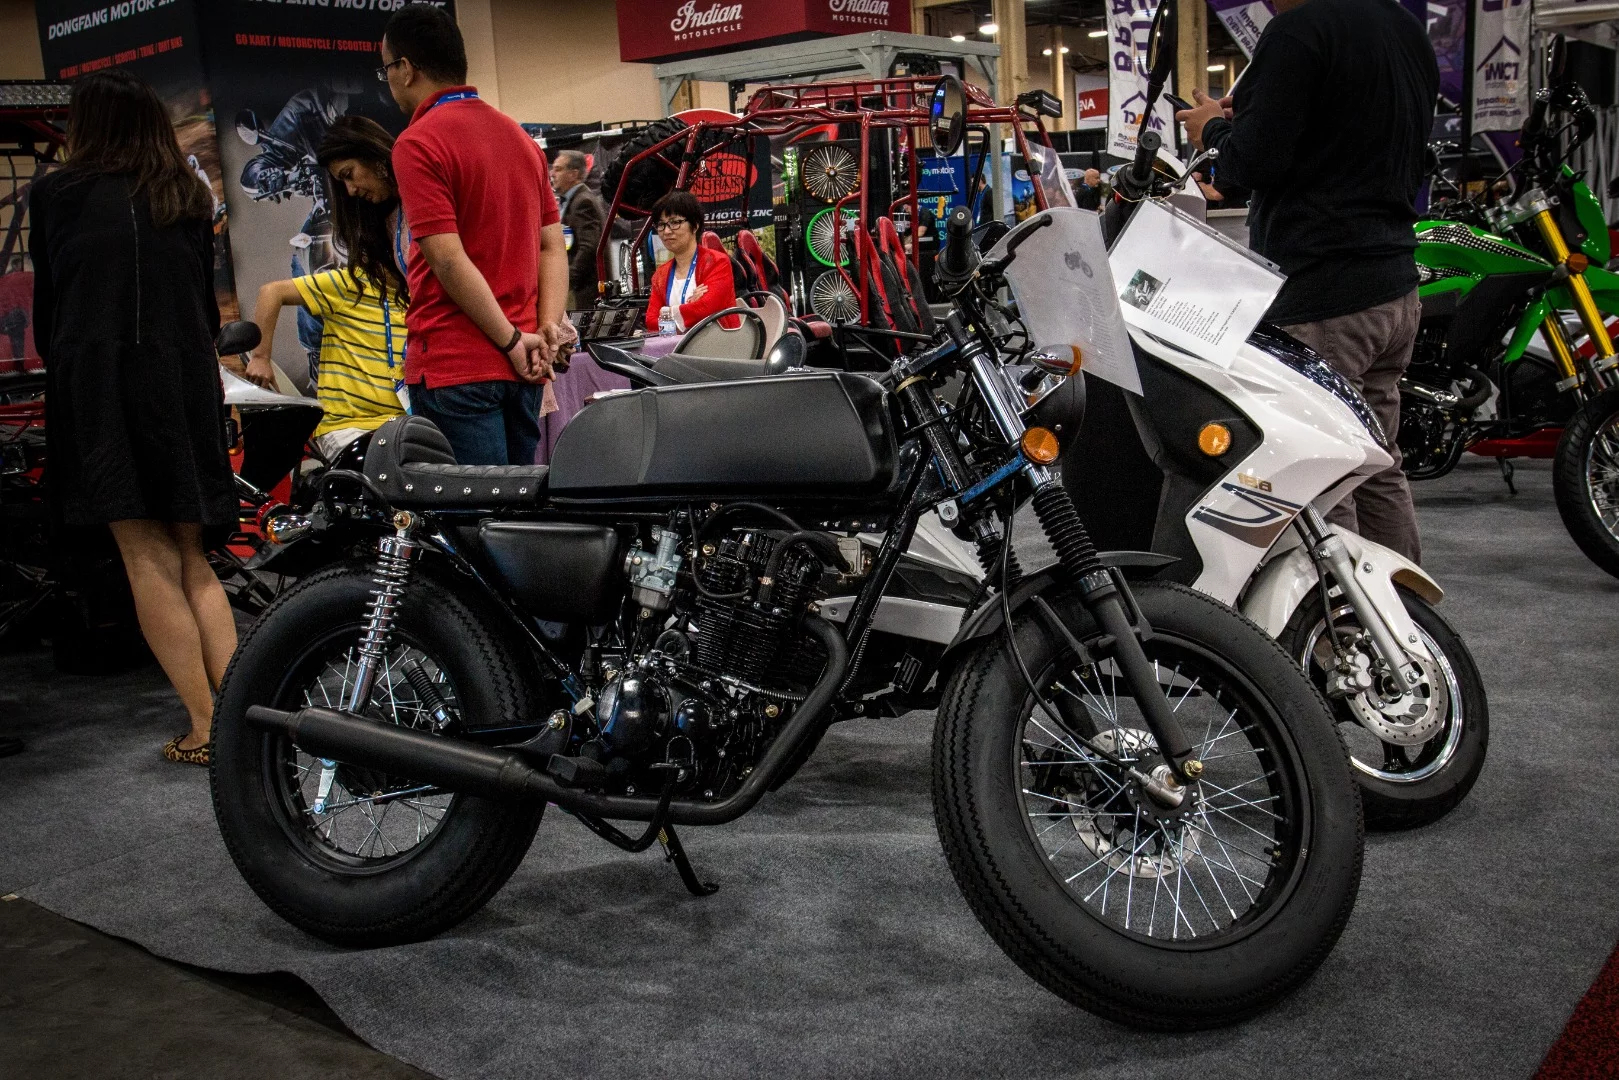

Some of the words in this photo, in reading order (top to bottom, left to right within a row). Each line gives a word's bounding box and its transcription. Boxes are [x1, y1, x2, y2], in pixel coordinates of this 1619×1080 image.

[670, 0, 742, 32] Indian
[829, 0, 889, 16] Indian
[48, 8, 108, 40] DONGFANG
[110, 0, 155, 22] MOTOR
[832, 14, 889, 26] MOTORCYCLE
[1225, 15, 1244, 38] EVENT
[674, 23, 742, 42] MOTORCYCLE
[235, 33, 248, 46] GO
[249, 34, 271, 47] KART
[278, 36, 331, 50] MOTORCYCLE
[337, 40, 372, 52] SCOOTER
[752, 208, 774, 217] INC
